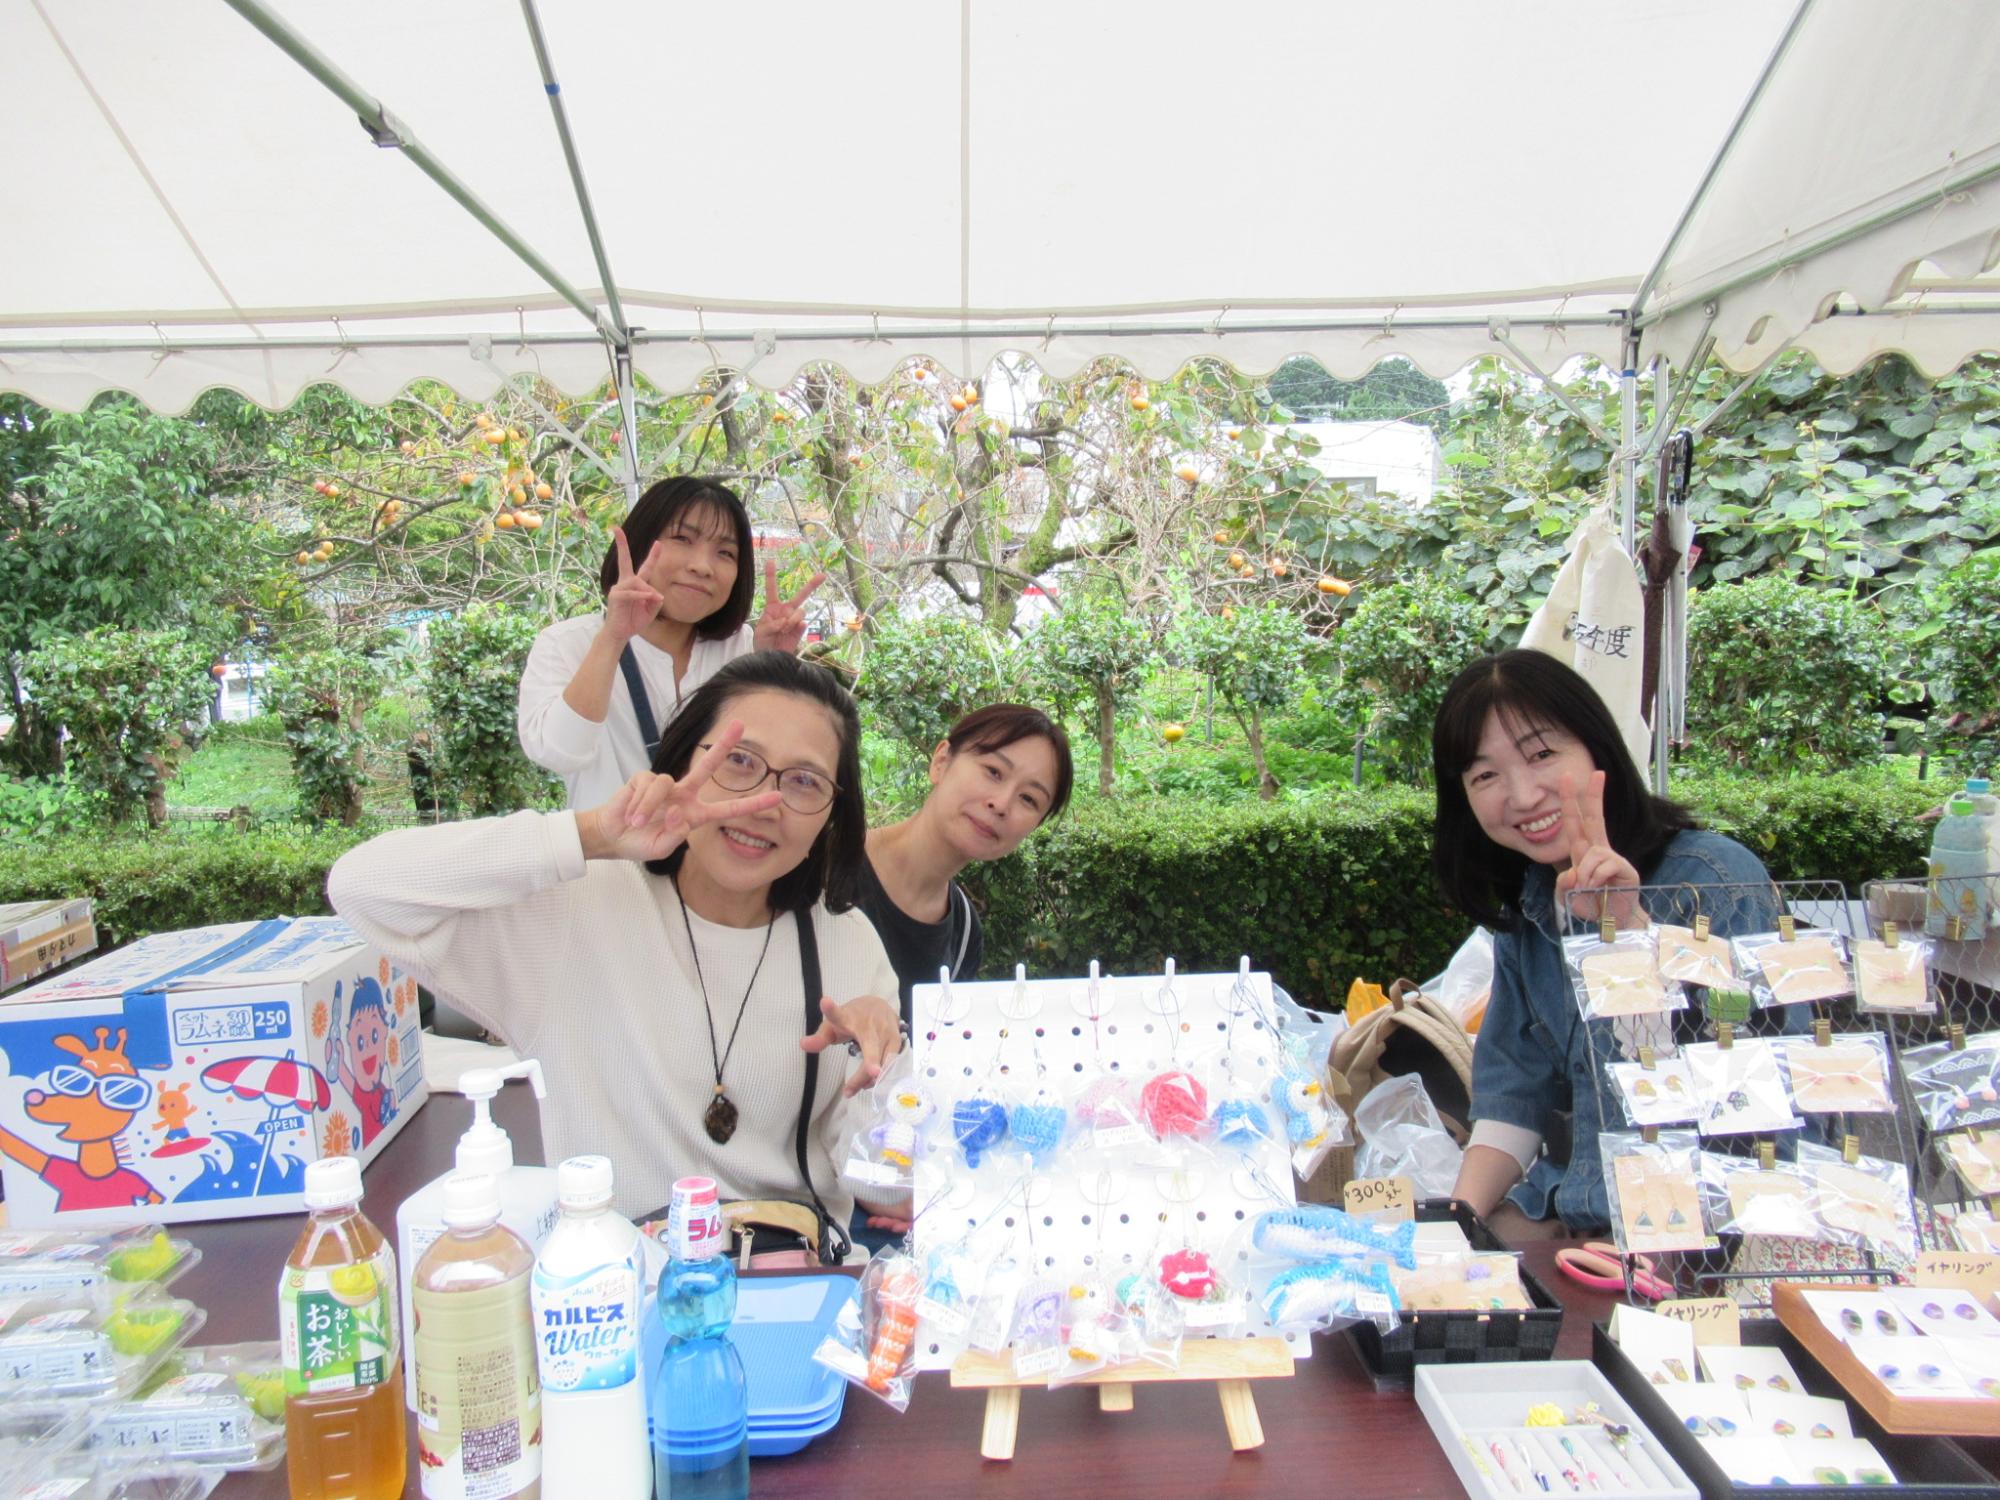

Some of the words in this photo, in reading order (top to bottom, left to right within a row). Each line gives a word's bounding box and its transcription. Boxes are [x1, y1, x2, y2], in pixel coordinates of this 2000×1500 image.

[255, 1009, 287, 1027] 250
[180, 1019, 227, 1041] ラムネ
[265, 1025, 279, 1034] ml
[264, 1118, 298, 1132] OPEN
[1925, 1261, 1992, 1275] イヤリング
[544, 1303, 624, 1326] カルピス
[1663, 1303, 1728, 1321] イヤリング
[306, 1303, 336, 1368] お茶
[334, 1306, 352, 1361] おいしい
[544, 1325, 627, 1355] Water
